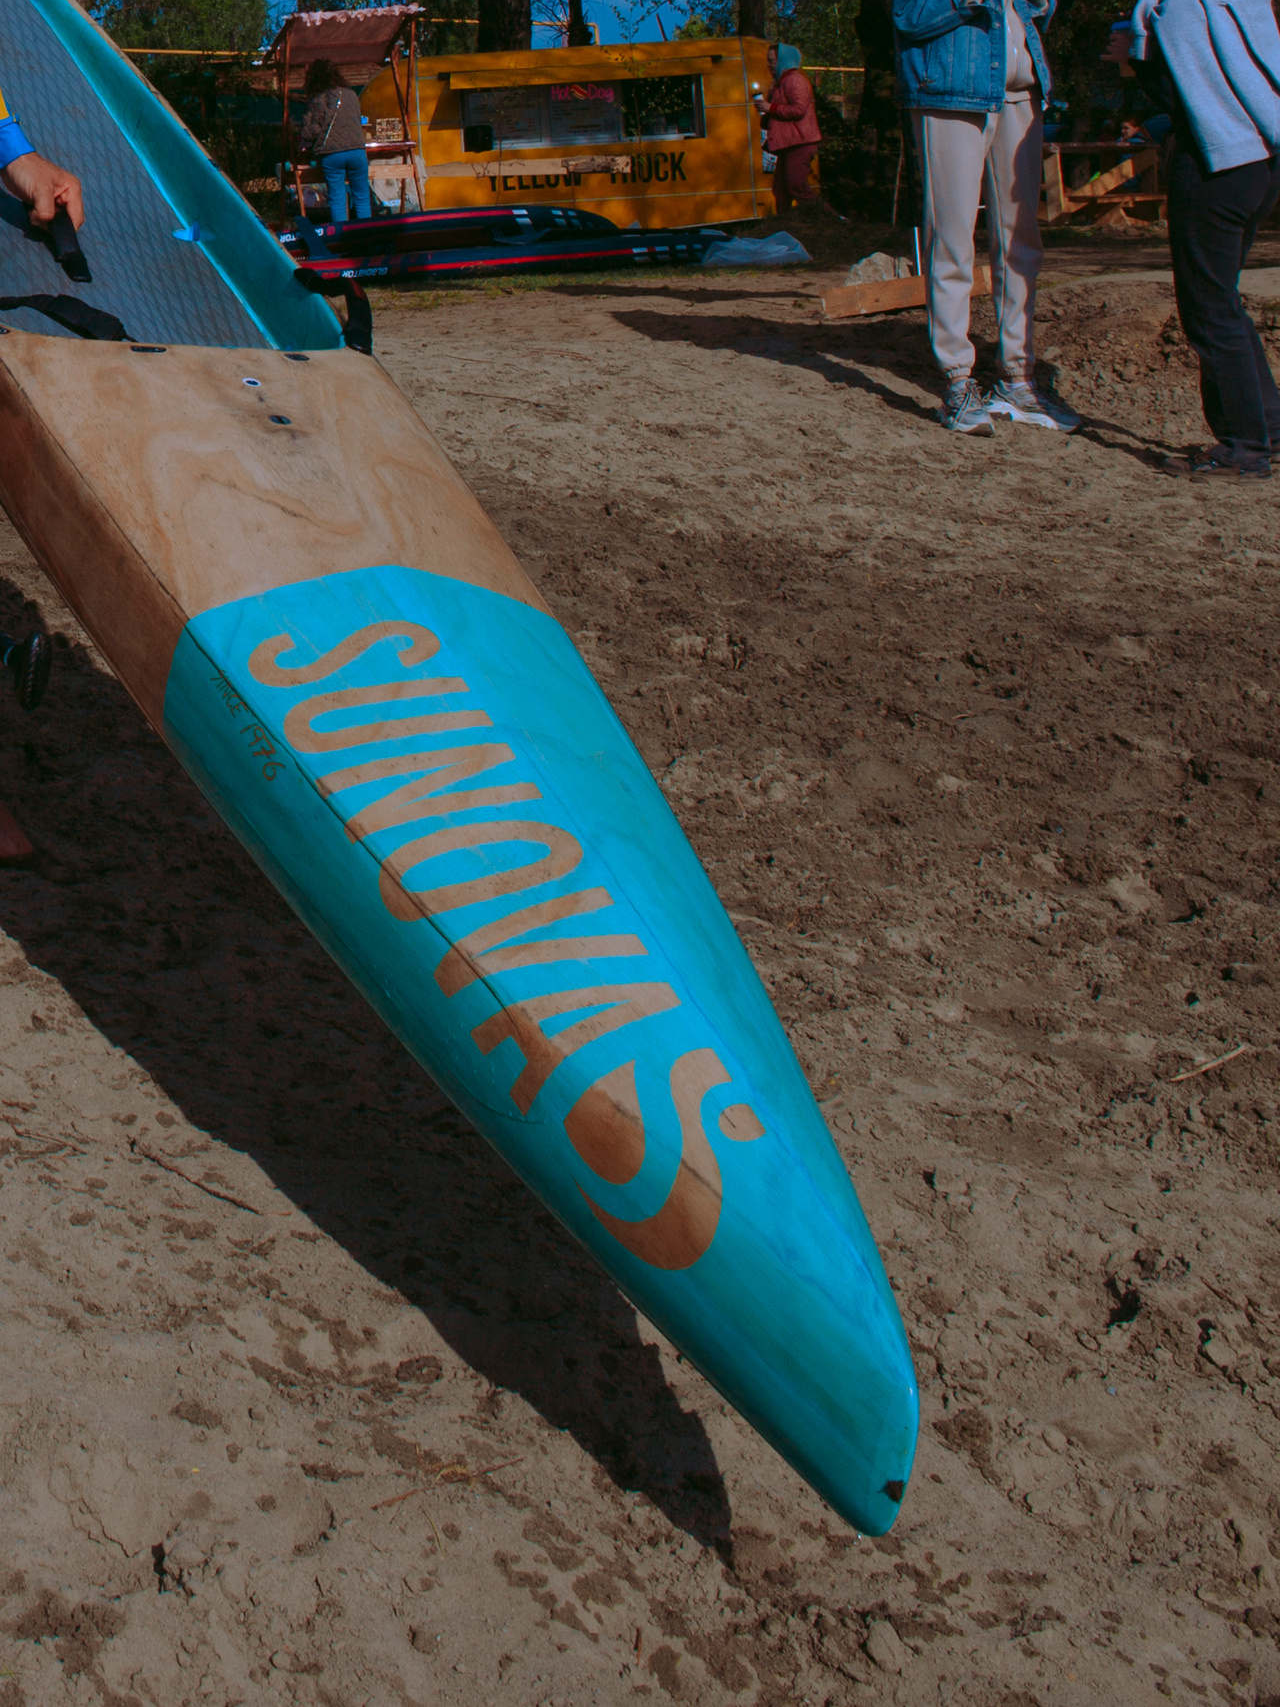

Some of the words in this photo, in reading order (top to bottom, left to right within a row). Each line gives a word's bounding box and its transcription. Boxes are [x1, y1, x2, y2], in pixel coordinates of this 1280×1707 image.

[551, 85, 571, 101] Hot
[587, 83, 615, 103] Dog
[240, 723, 287, 782] 1976
[247, 620, 682, 1116] SUNOVA
